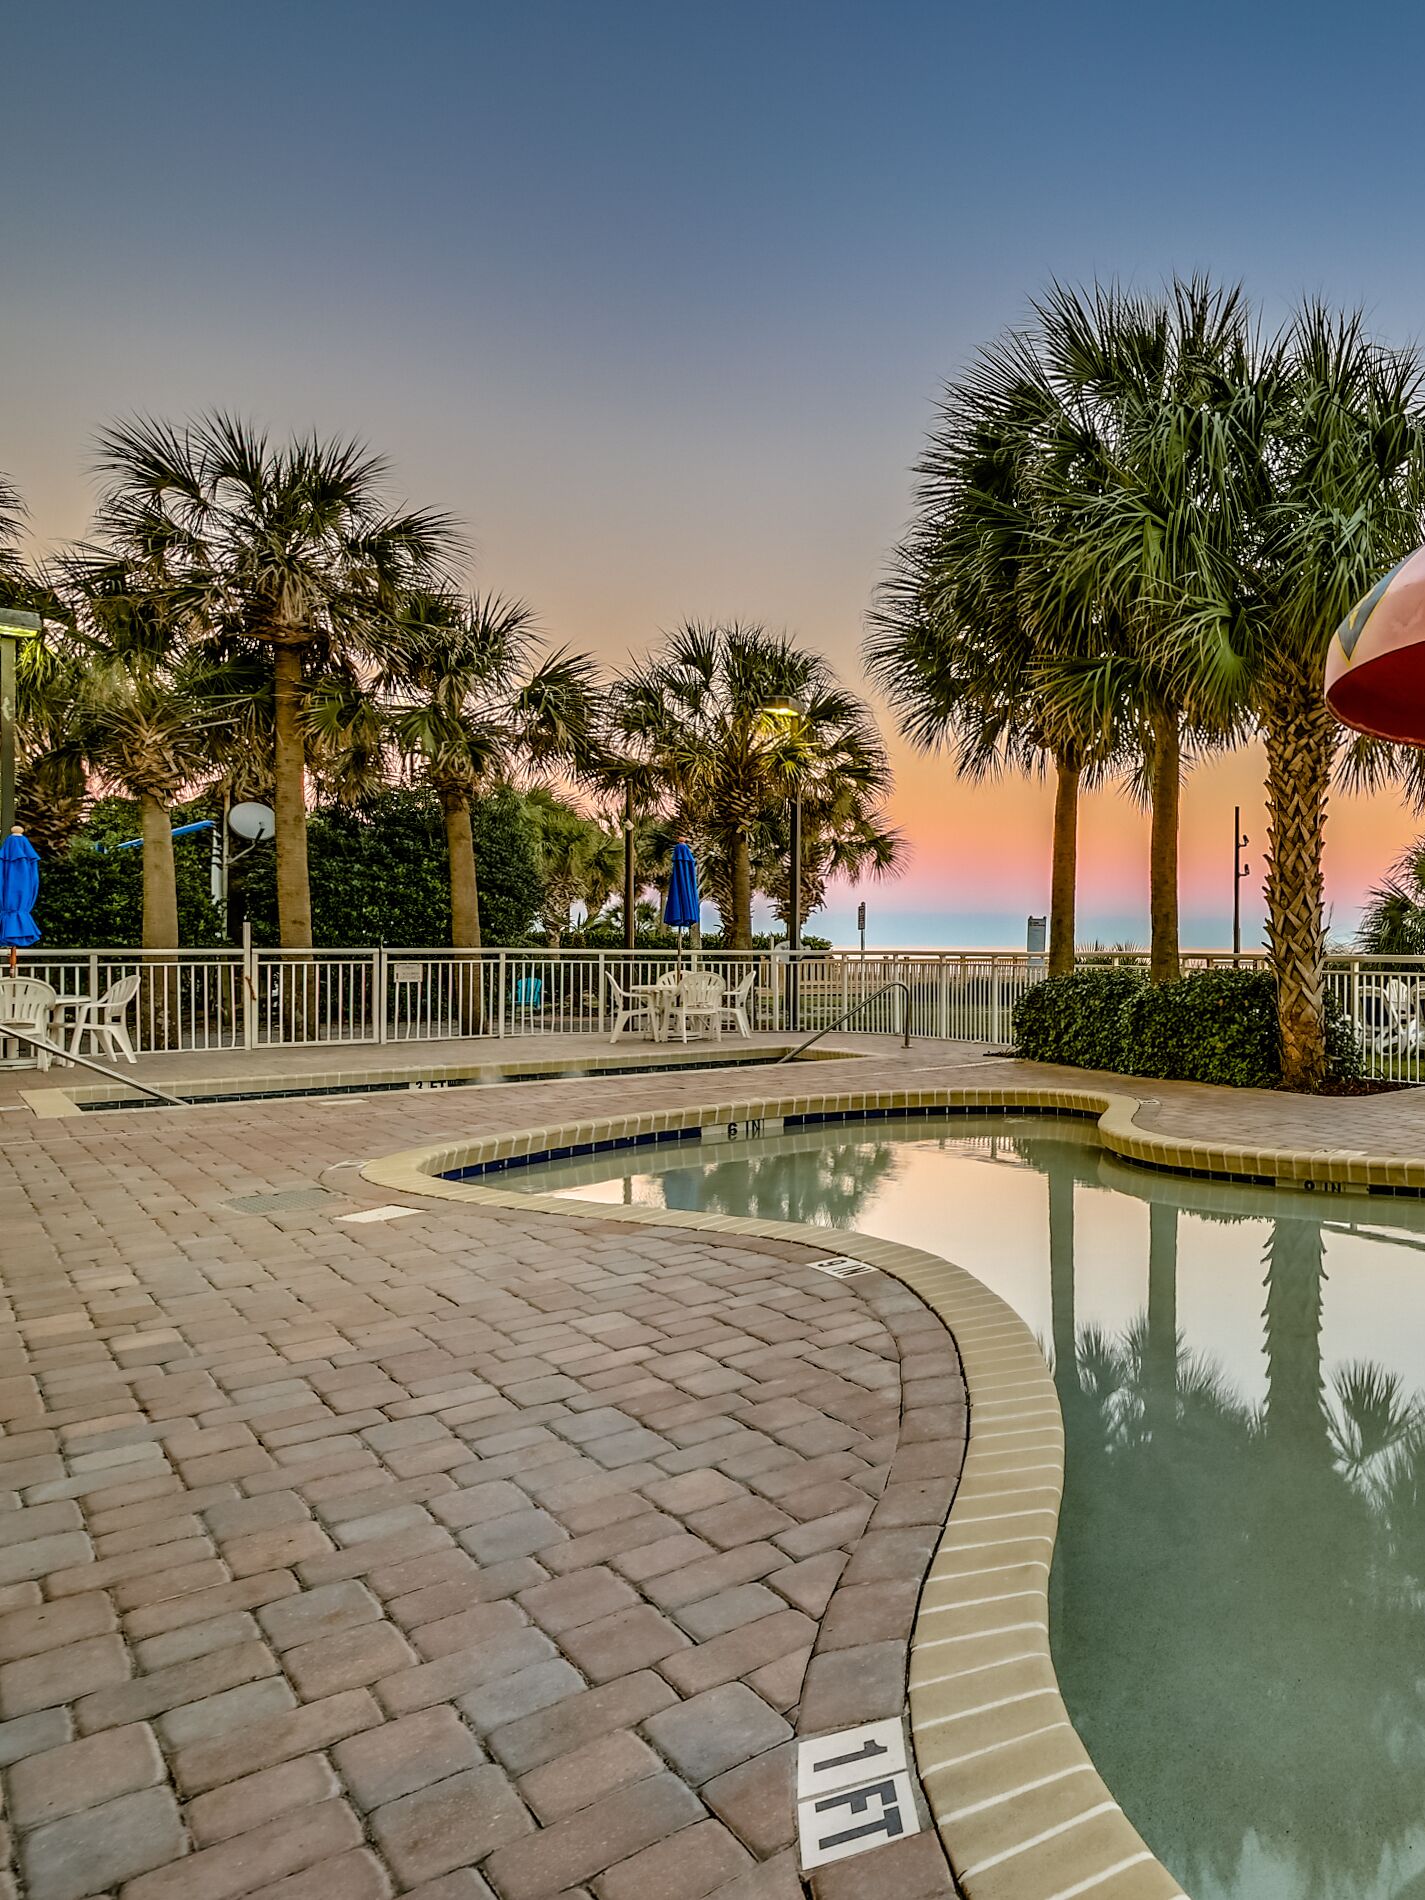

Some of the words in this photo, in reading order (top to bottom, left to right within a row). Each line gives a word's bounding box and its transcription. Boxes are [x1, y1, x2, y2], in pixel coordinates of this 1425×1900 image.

[728, 1122, 738, 1135] 6
[833, 1264, 872, 1276] IN
[814, 1740, 888, 1772] 1
[815, 1779, 903, 1850] FT
